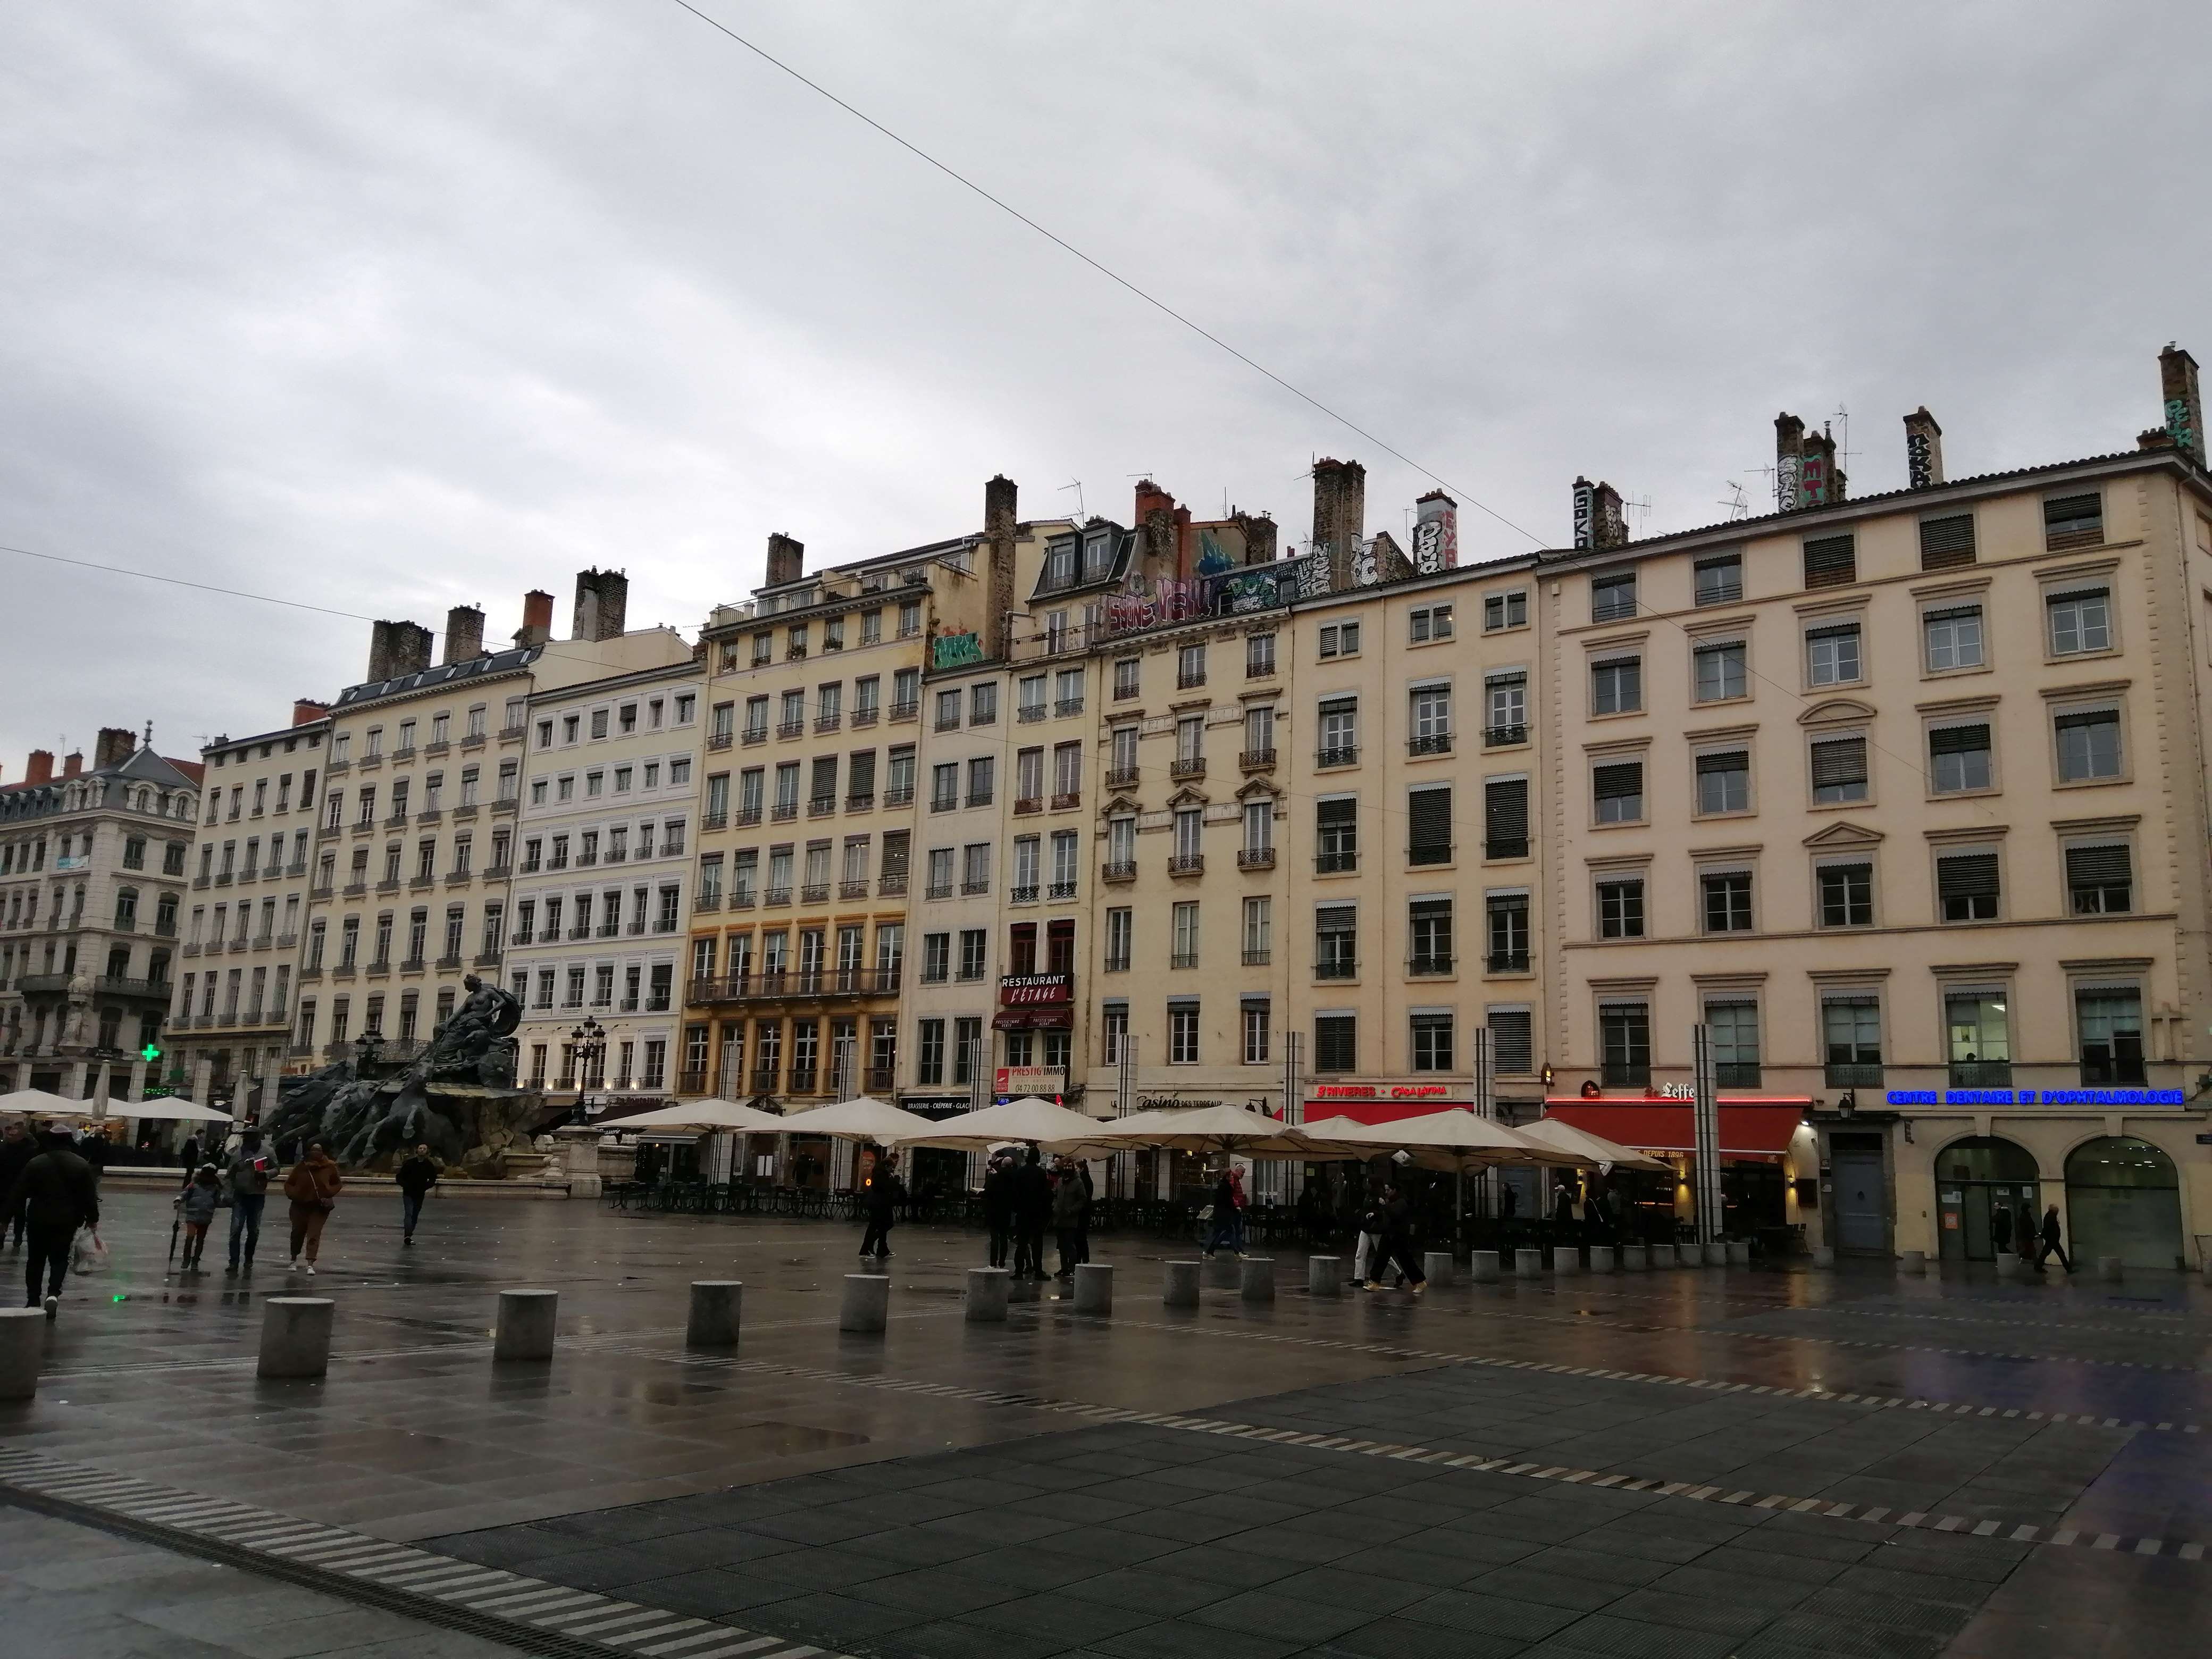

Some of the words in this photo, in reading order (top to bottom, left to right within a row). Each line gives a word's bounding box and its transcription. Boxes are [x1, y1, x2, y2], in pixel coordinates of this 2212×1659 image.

[1002, 975, 1066, 987] RESTAURANT
[1015, 1084, 1023, 1093] 04
[1024, 1084, 1030, 1093] 72
[1032, 1084, 1038, 1093] 00
[1040, 1084, 1046, 1093] 88
[1048, 1084, 1055, 1093] 88
[1661, 1082, 1695, 1101] Leffe
[1887, 1091, 1938, 1105] CENTRE
[1946, 1091, 2014, 1105] DENTAIRE
[2018, 1091, 2036, 1105] ET
[2042, 1091, 2183, 1105] D'OPHTALMOLOGIE
